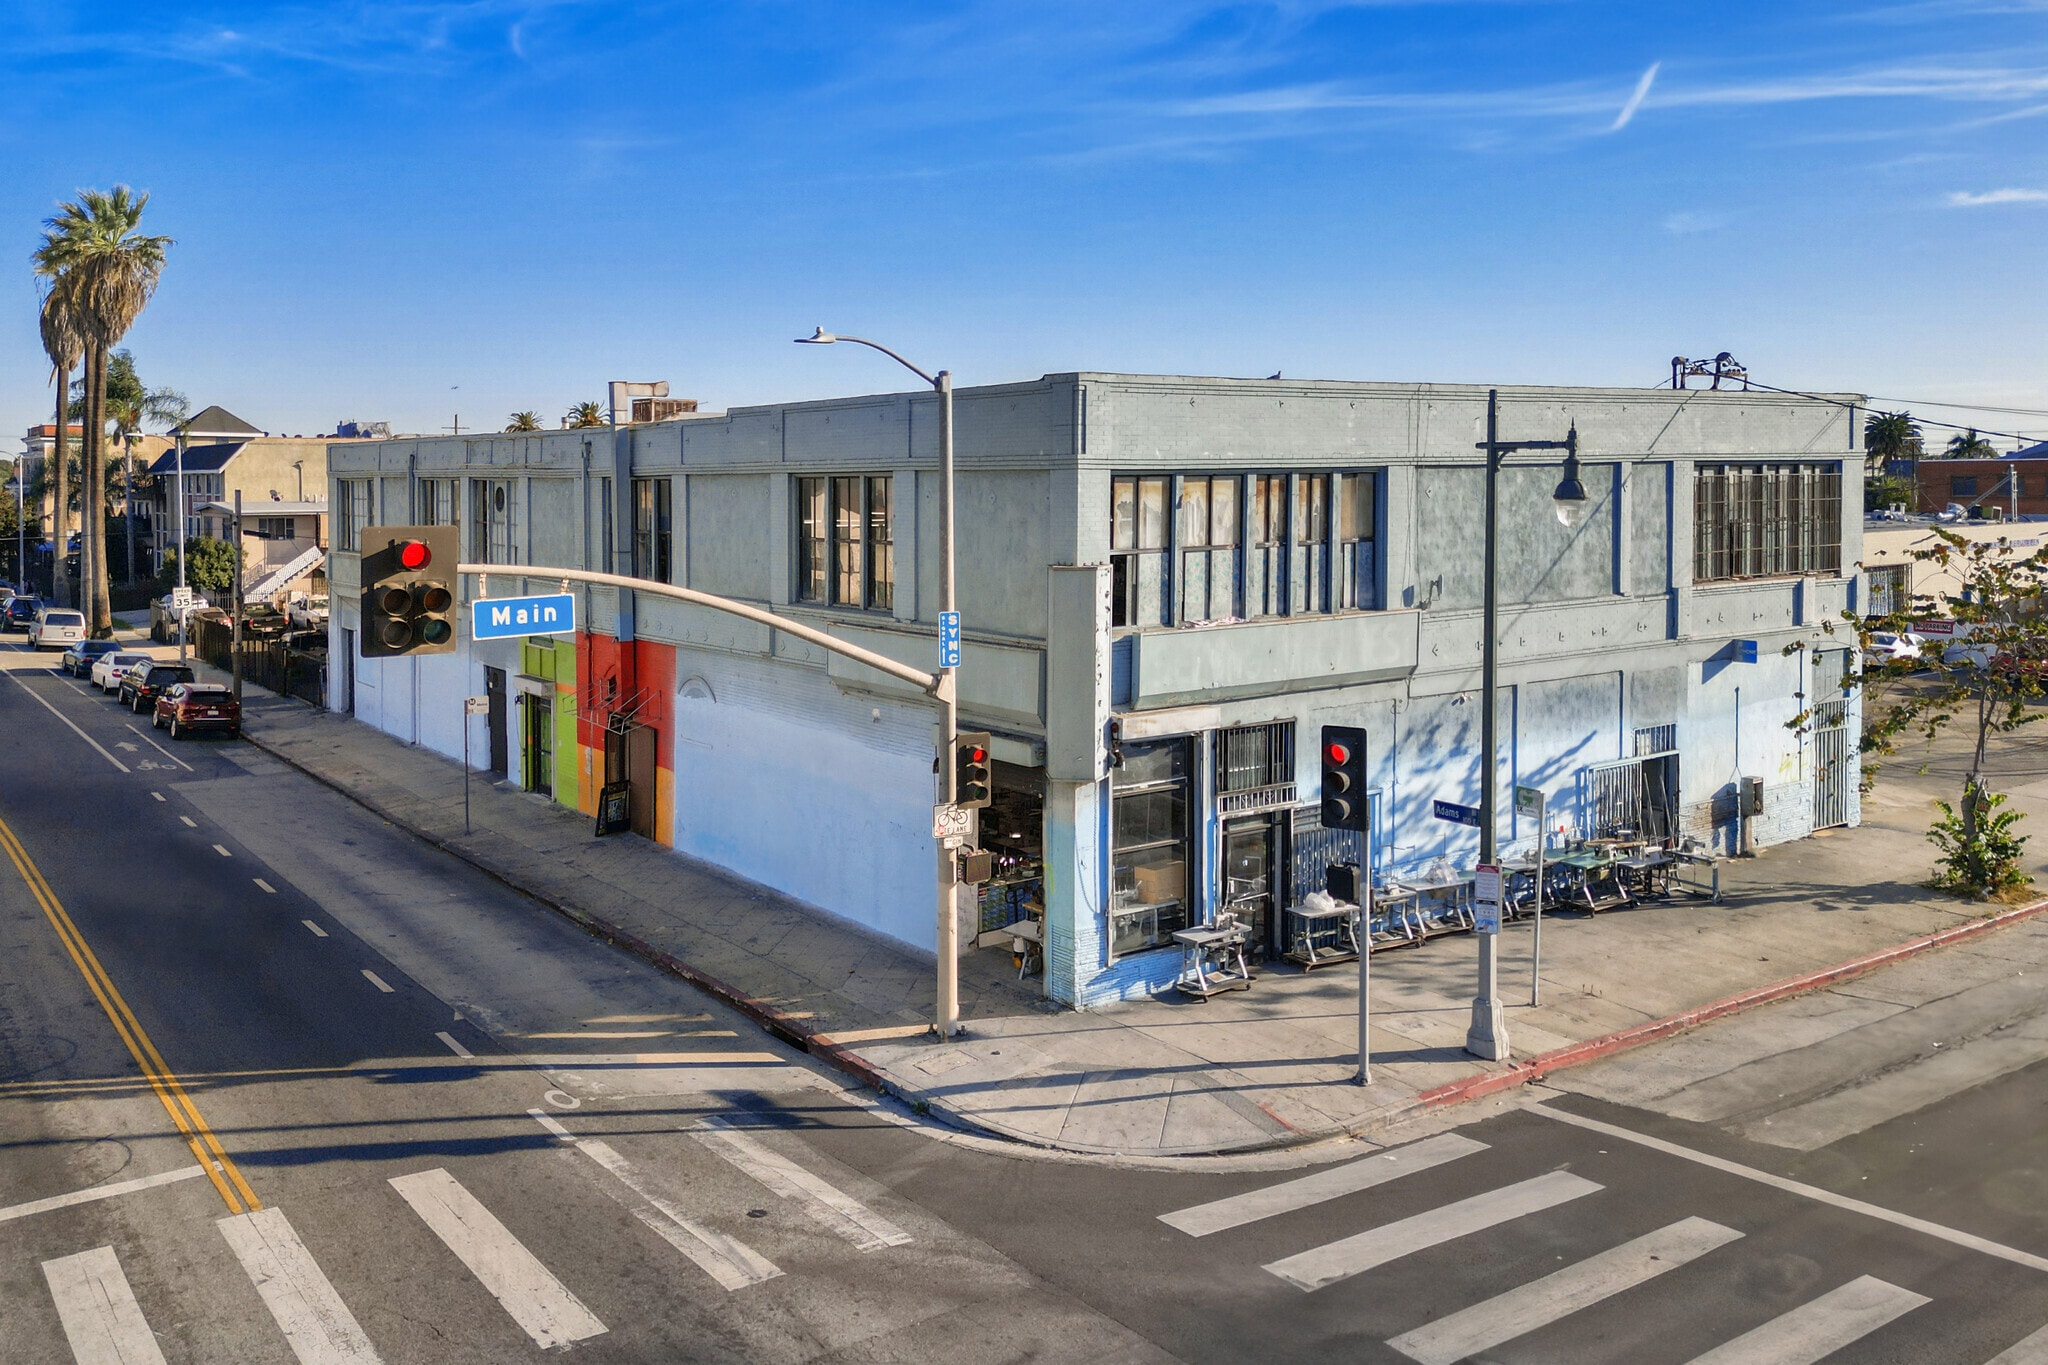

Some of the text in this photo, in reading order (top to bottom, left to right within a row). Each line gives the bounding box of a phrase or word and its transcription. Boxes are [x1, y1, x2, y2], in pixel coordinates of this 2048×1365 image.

[176, 598, 190, 606] 35
[491, 603, 557, 627] Main
[948, 615, 958, 664] SYNC
[1436, 805, 1460, 819] Adams
[953, 825, 967, 833] LANE
